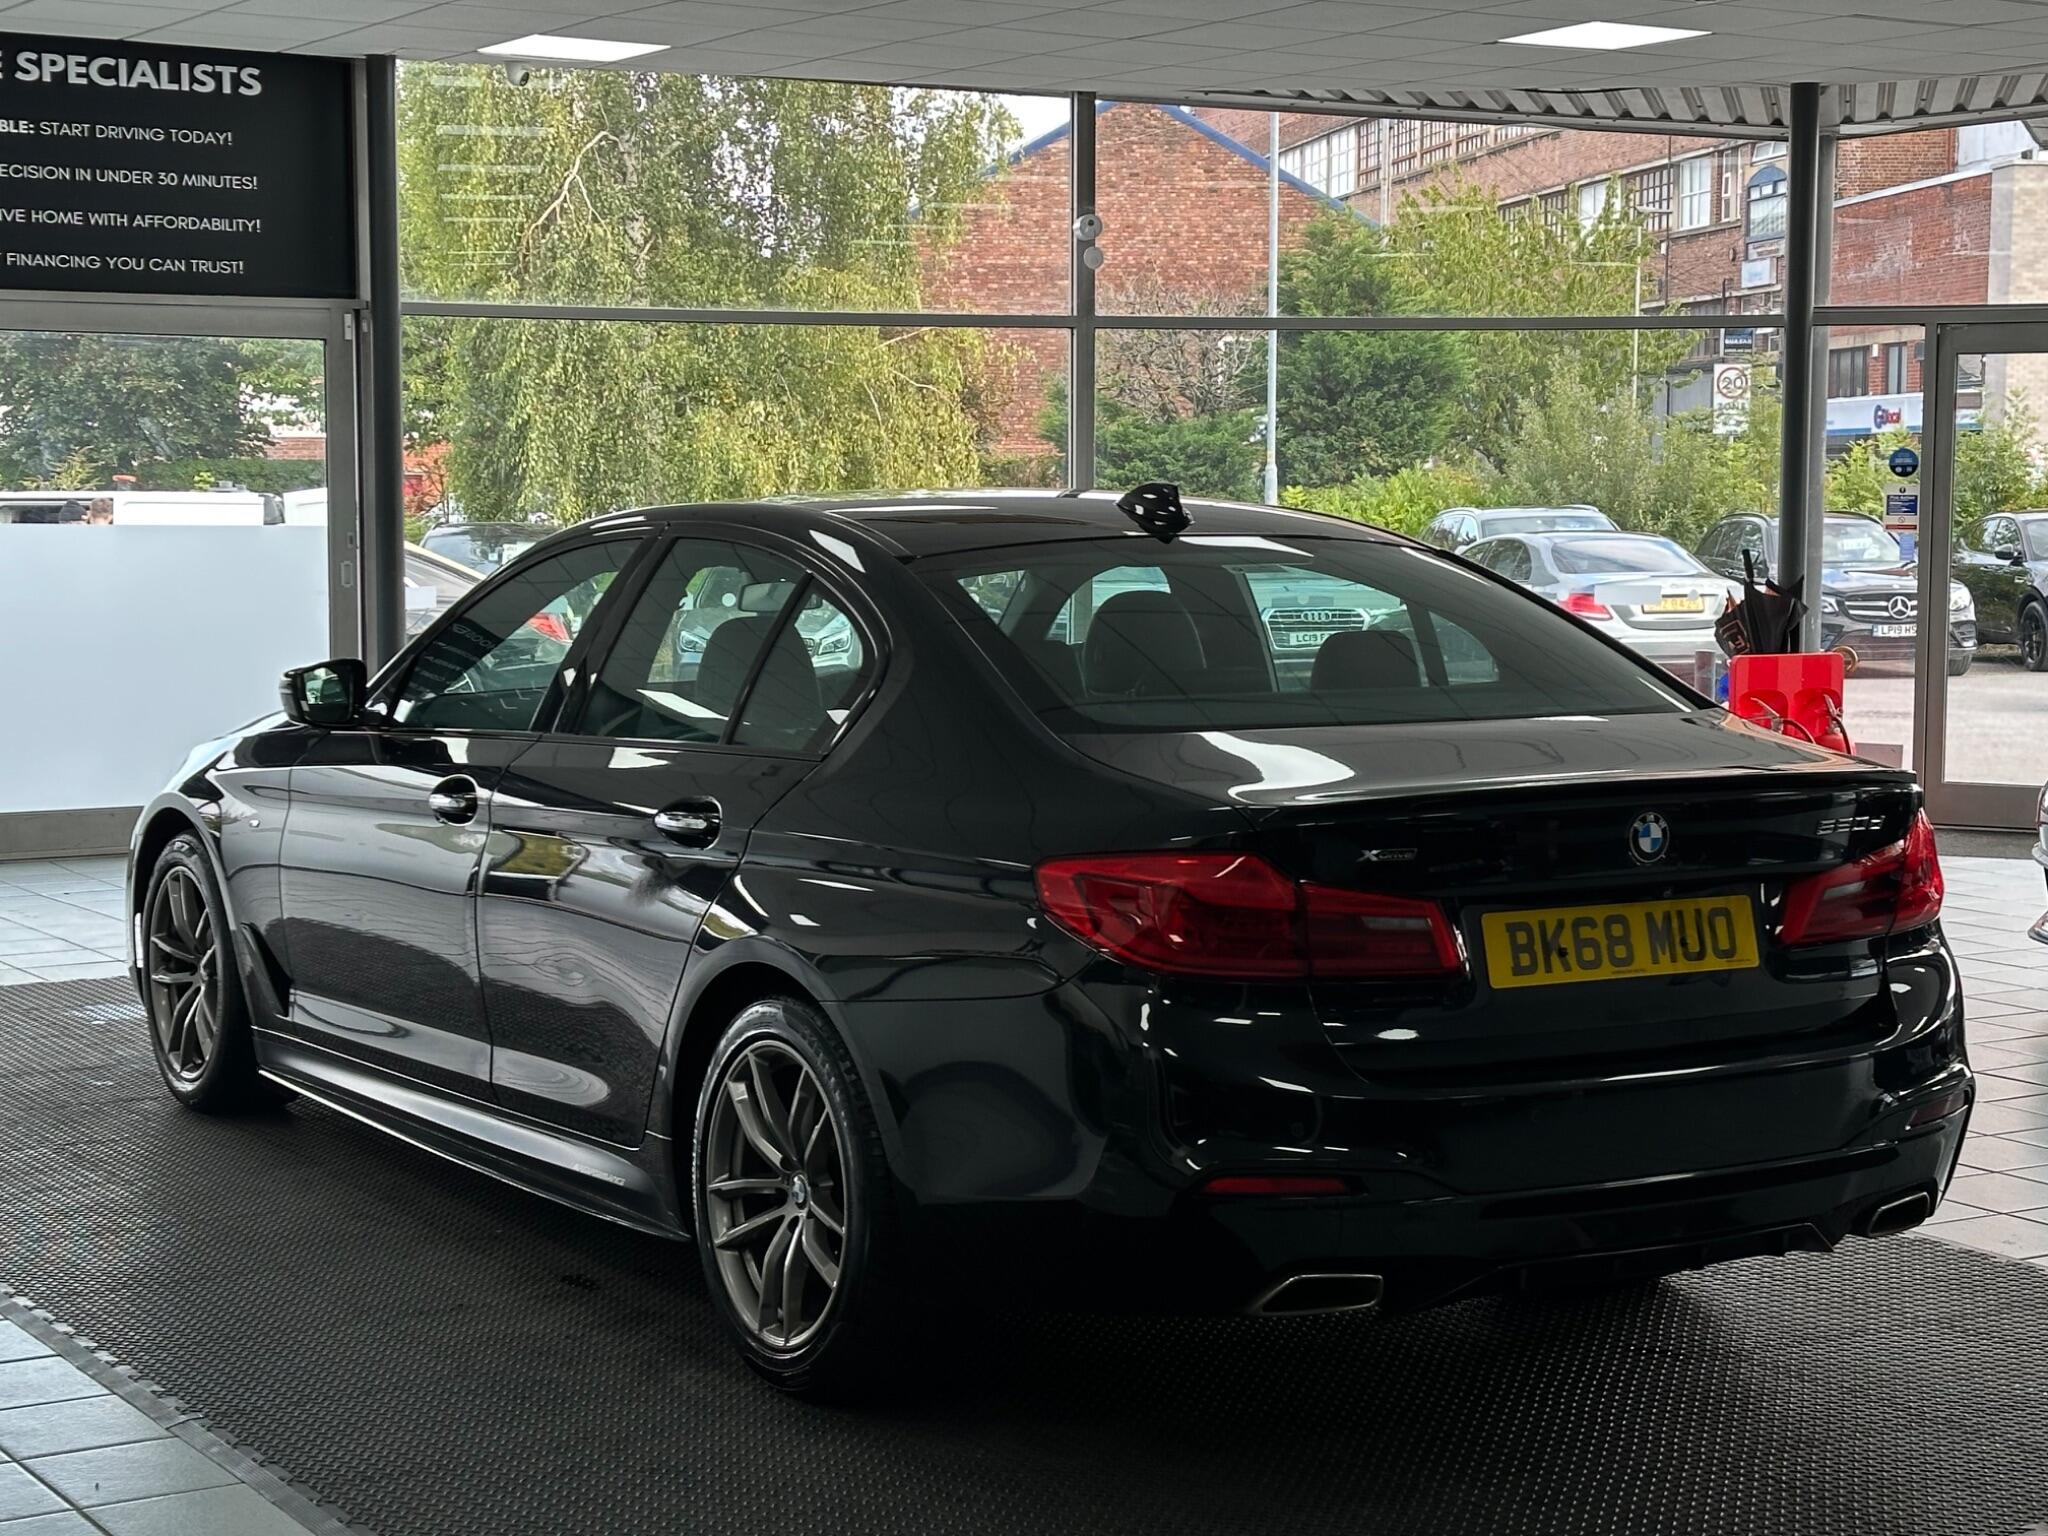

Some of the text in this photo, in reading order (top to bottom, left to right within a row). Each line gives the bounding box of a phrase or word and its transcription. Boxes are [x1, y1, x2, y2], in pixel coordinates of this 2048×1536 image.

[14, 51, 262, 96] SPECIALISTS
[40, 122, 90, 137] START
[96, 125, 165, 141] DRIVING
[171, 129, 233, 145] TODAY!
[0, 164, 257, 189] ECISION IN UNDER 30 MINUTES!
[31, 210, 83, 225] HOME
[88, 213, 128, 226] WITH
[133, 215, 261, 232] AFFORDABILITY!
[7, 253, 243, 274] FINANCING YOU CAN TRUST!
[1722, 376, 1744, 390] 20
[1505, 907, 1737, 976] BK68 MUO
